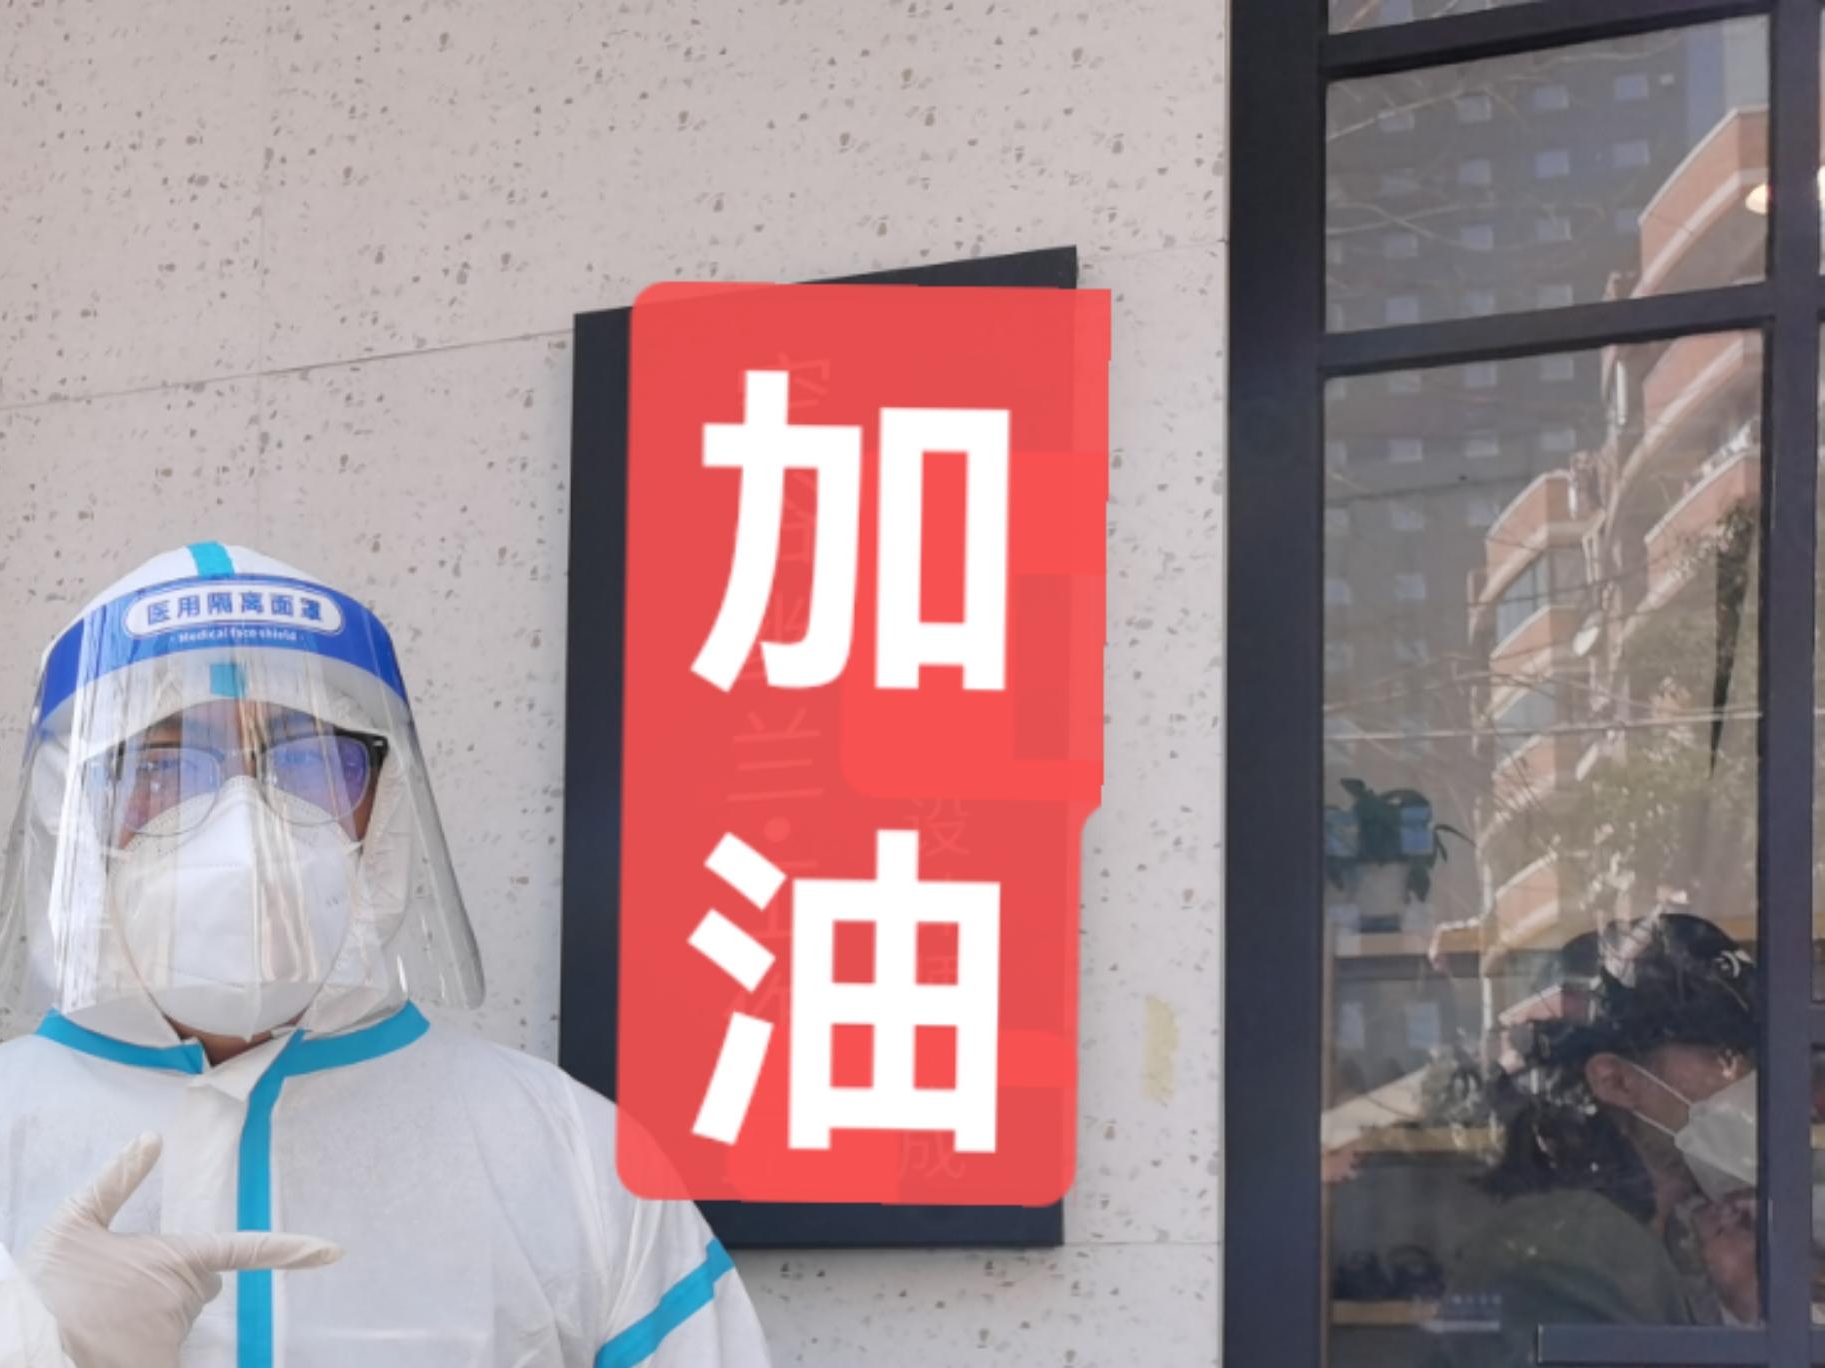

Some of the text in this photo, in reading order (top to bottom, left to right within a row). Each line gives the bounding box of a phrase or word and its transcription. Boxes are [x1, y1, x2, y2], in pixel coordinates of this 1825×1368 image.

[147, 590, 323, 626] 医用隔离面罩
[179, 627, 227, 643] Medical
